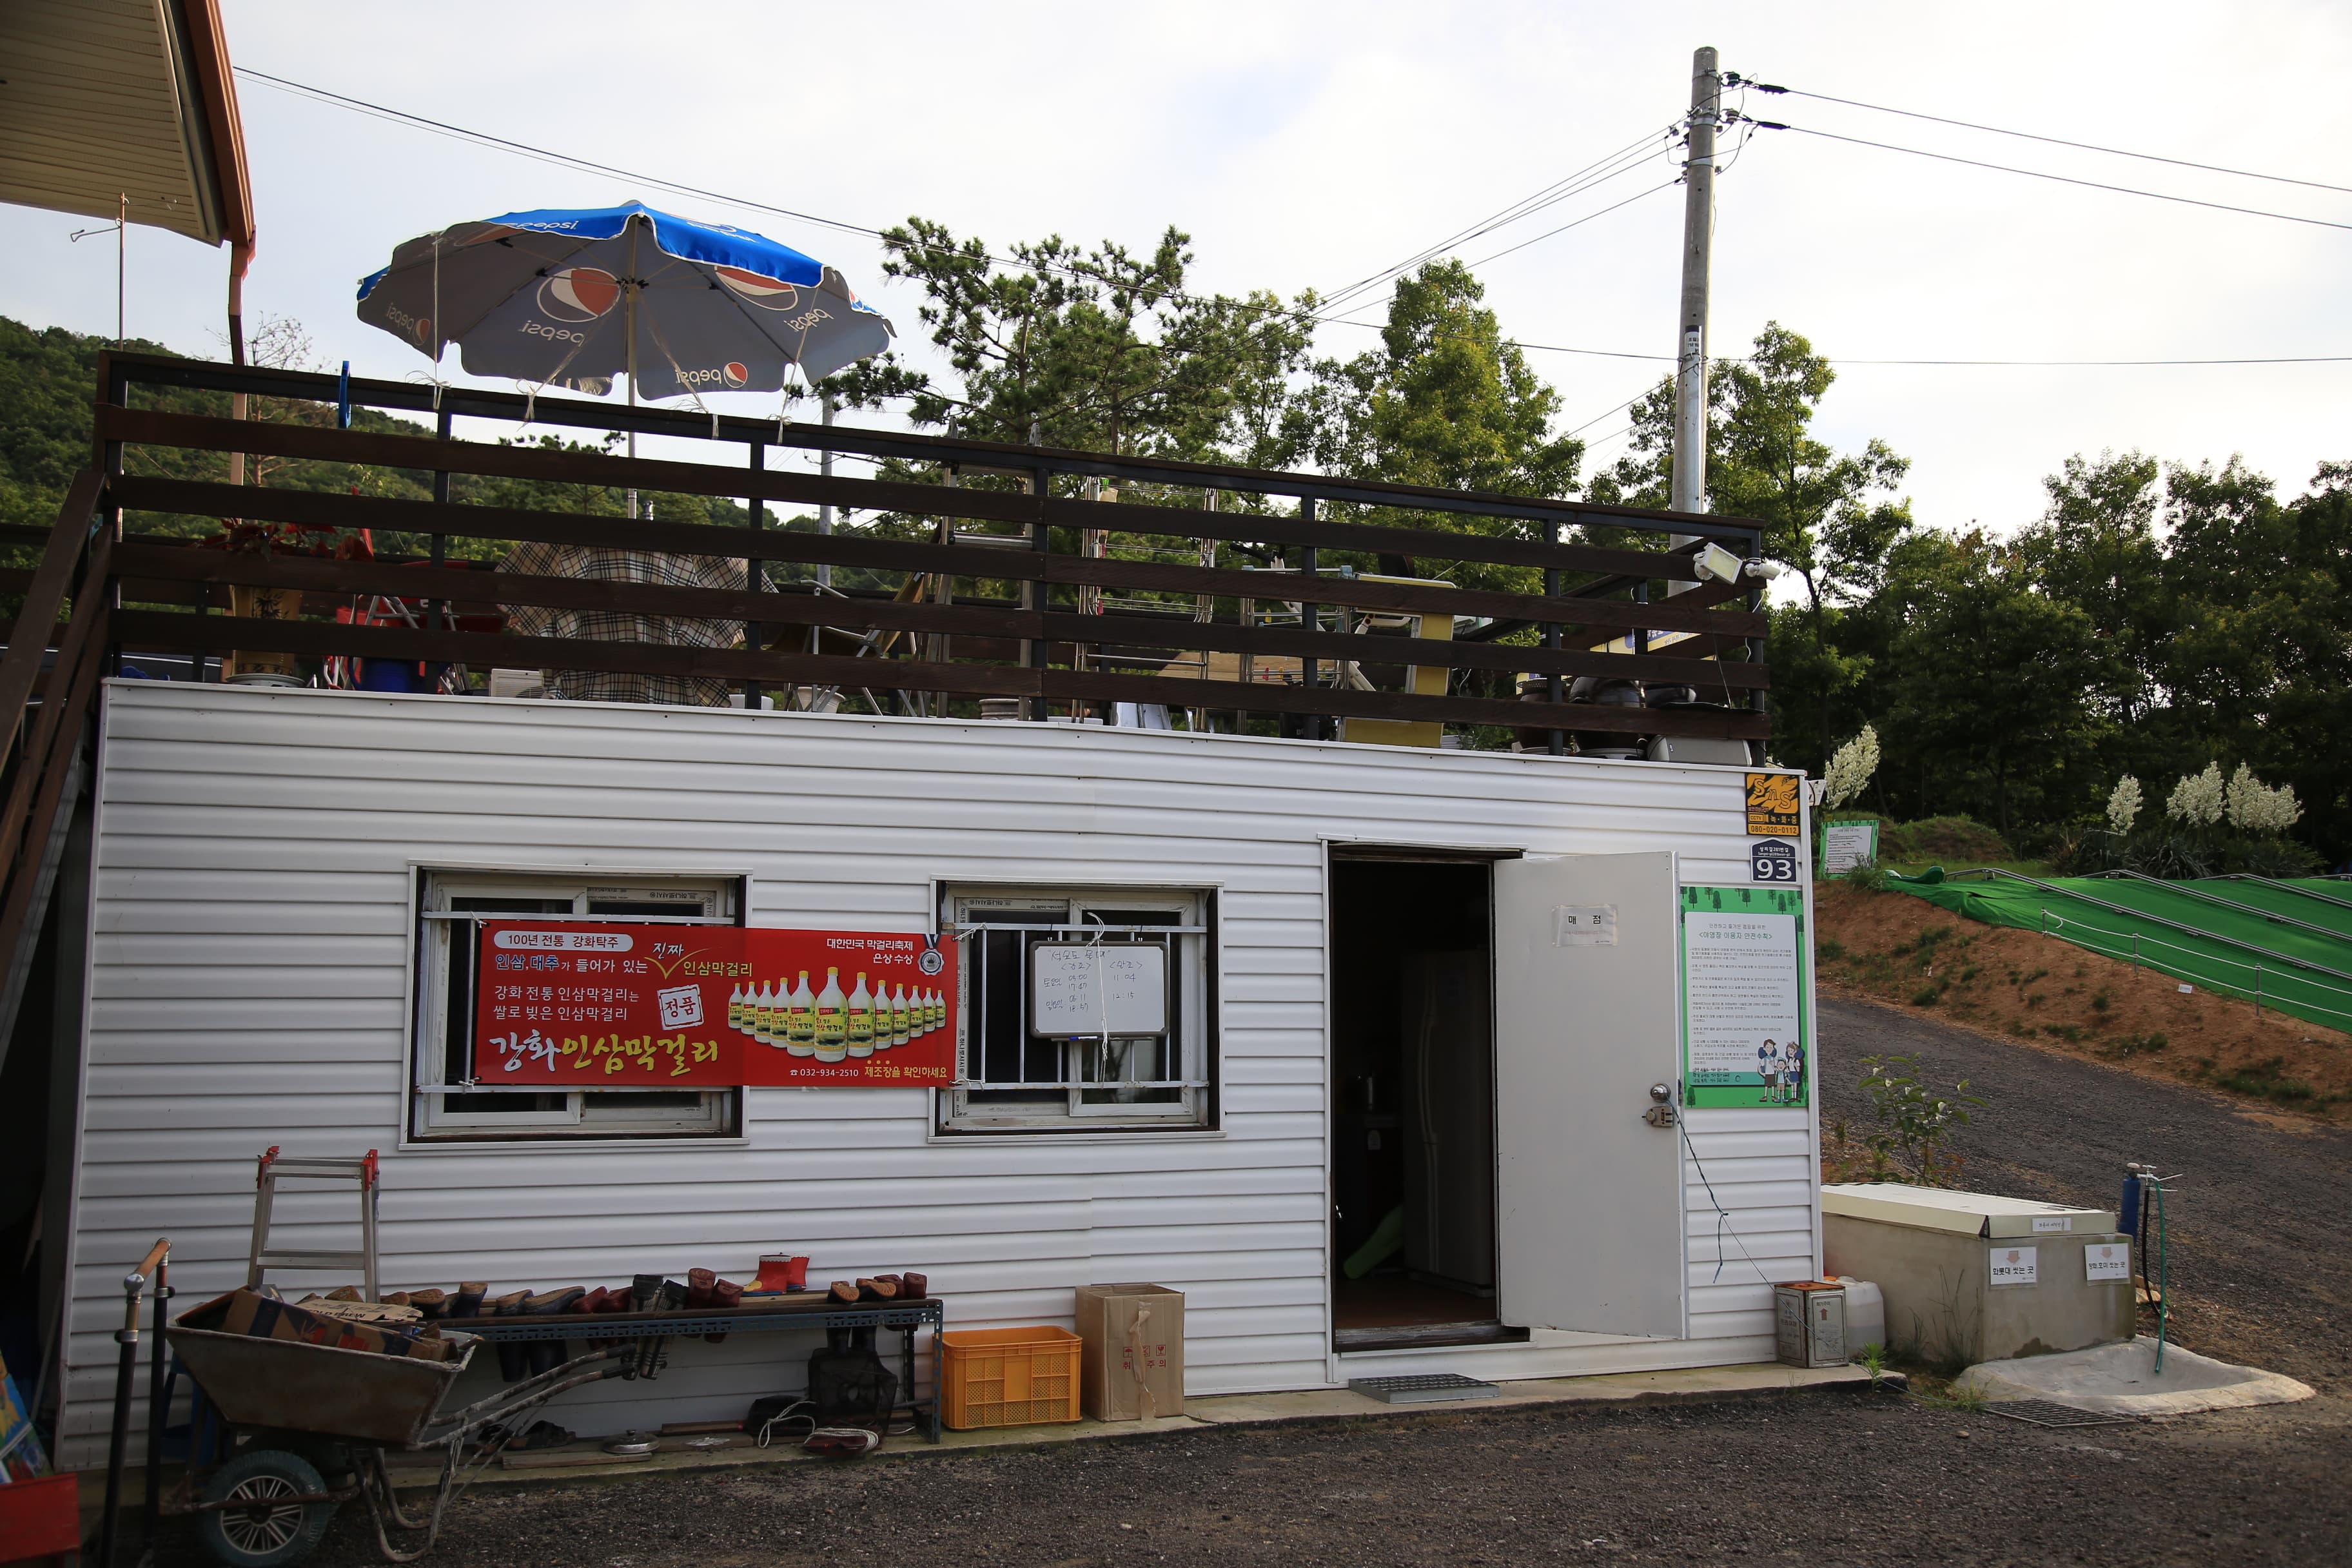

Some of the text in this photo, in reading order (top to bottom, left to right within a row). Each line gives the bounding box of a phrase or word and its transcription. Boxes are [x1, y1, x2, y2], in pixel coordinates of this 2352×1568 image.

[1750, 825, 1797, 834] 080-020-0112
[1756, 859, 1792, 880] 93
[508, 934, 619, 948] 100년 전통 강화탁주
[827, 938, 914, 951] 대한민국 막걸리축제
[652, 942, 685, 959] 진짜
[575, 959, 615, 973] 들어가
[623, 959, 649, 974] 있는
[873, 954, 914, 965] 은상 수상
[683, 961, 752, 977] 인삼막걸리
[495, 985, 640, 1003] 강화 전통 인삼막걸리는
[493, 1005, 627, 1022] 쌀로 빚은 인삼막걸리
[664, 995, 697, 1019] 정품
[800, 1066, 947, 1079] 032-934-2510 제조장을 확인하세요
